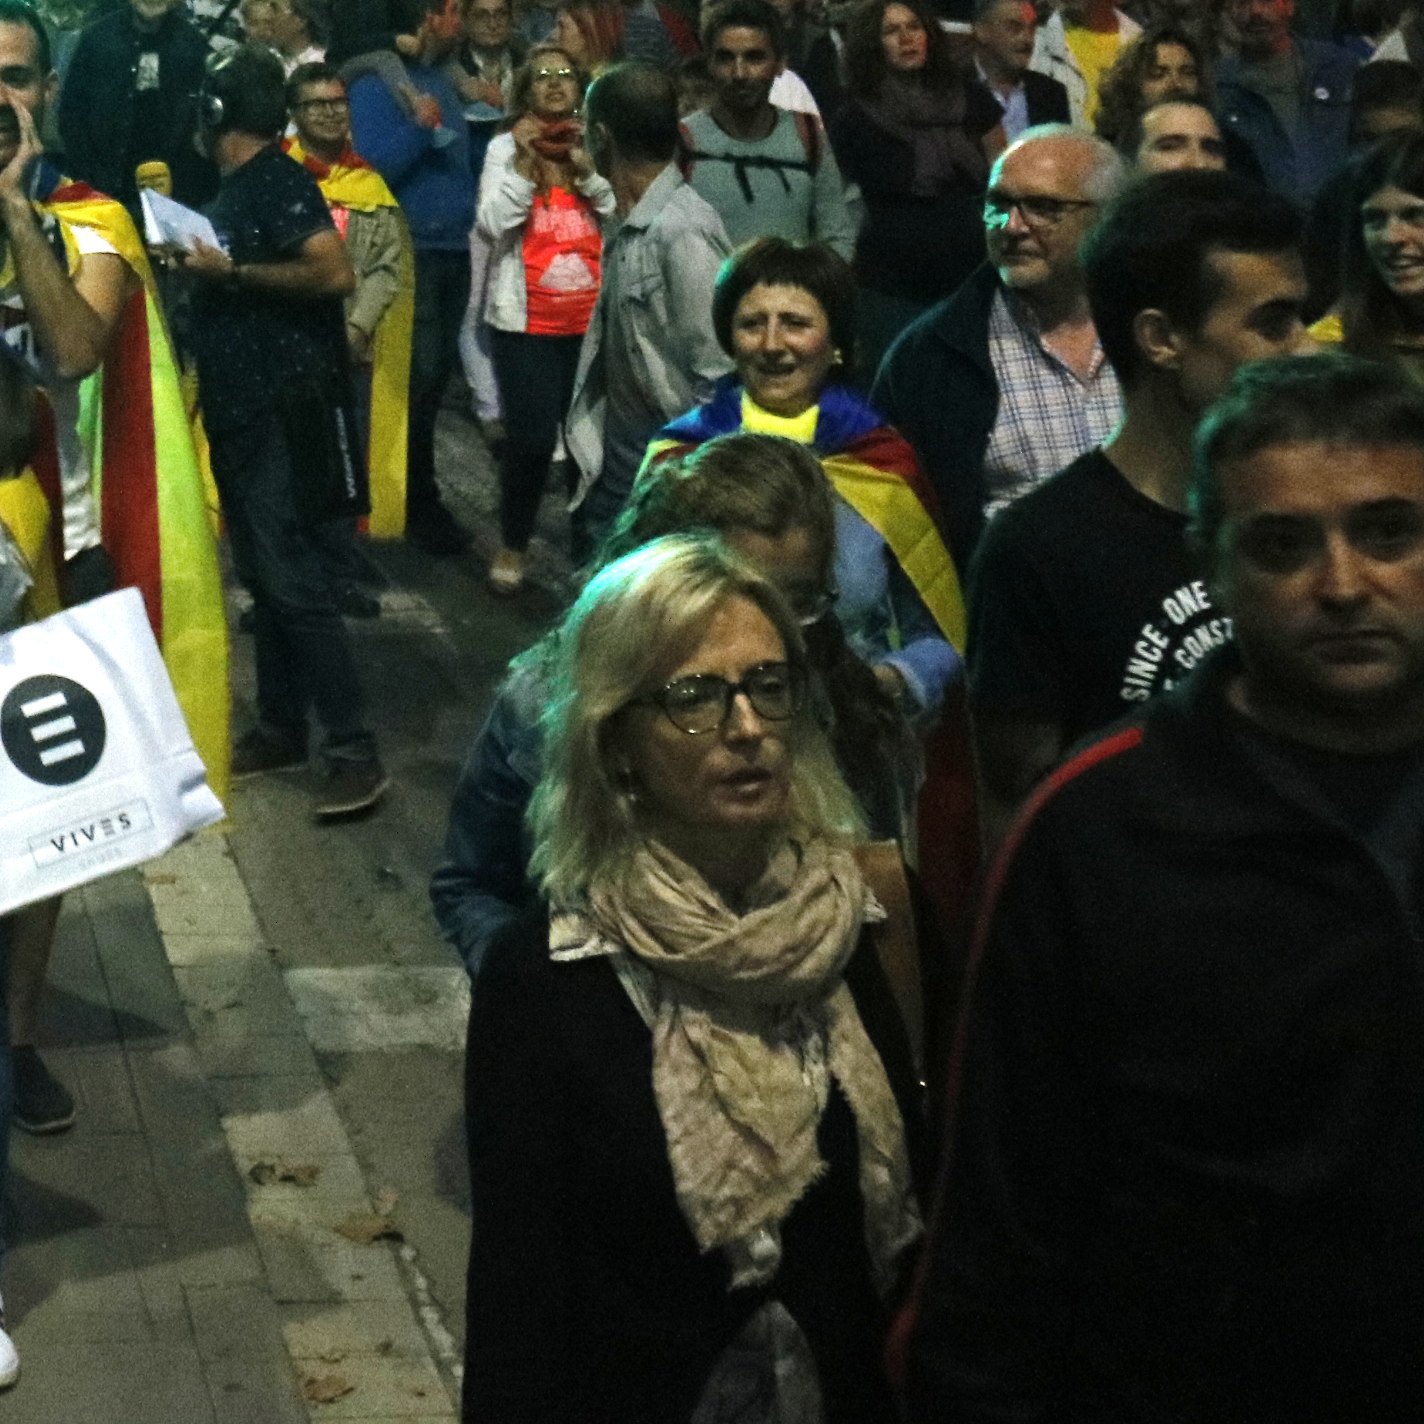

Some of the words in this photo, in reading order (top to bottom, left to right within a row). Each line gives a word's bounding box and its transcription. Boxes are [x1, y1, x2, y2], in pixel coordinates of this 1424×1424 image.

[1119, 623, 1171, 702] SINCE
[1162, 580, 1212, 625] ONE
[50, 812, 132, 852] VIVES
